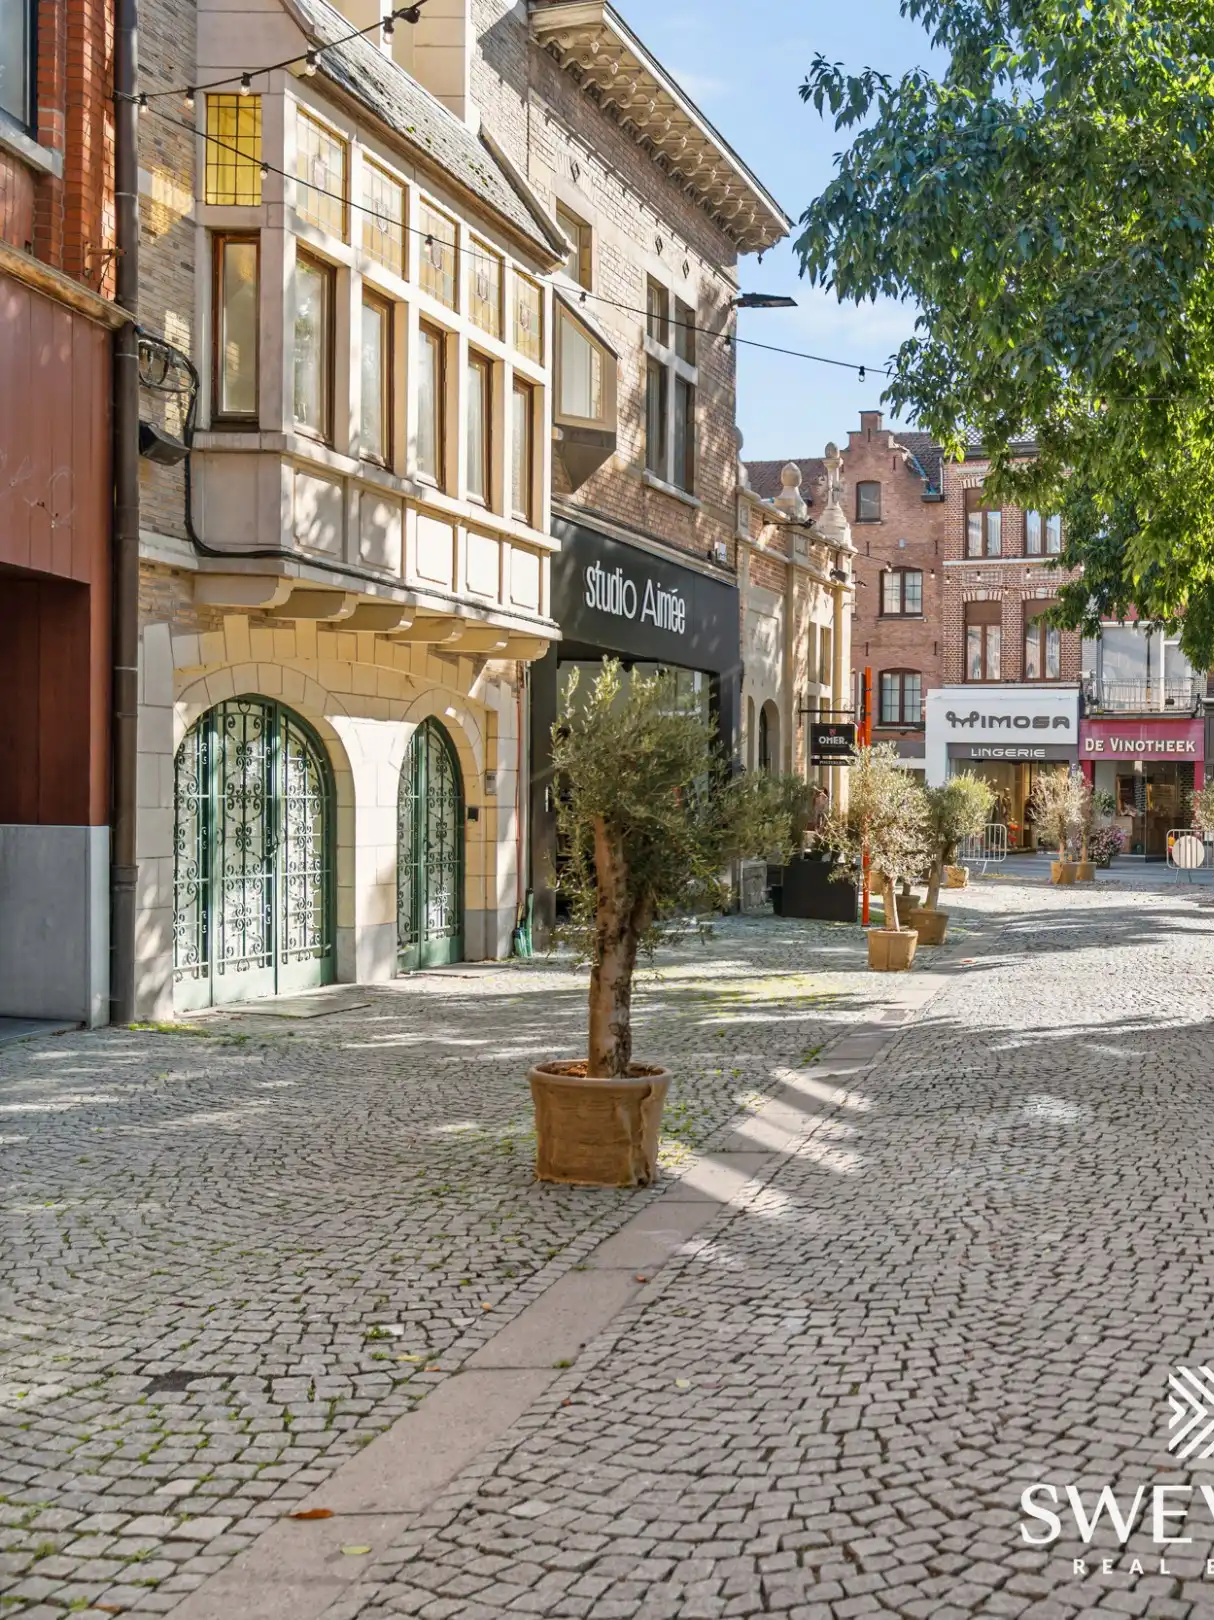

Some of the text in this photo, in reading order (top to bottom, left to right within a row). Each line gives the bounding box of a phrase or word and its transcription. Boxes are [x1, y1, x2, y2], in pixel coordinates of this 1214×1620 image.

[586, 560, 686, 635] studio Aimée
[945, 711, 1070, 729] MIMOSA
[971, 748, 1046, 758] LINGERIE
[1085, 737, 1196, 753] DE VINOTHEEK
